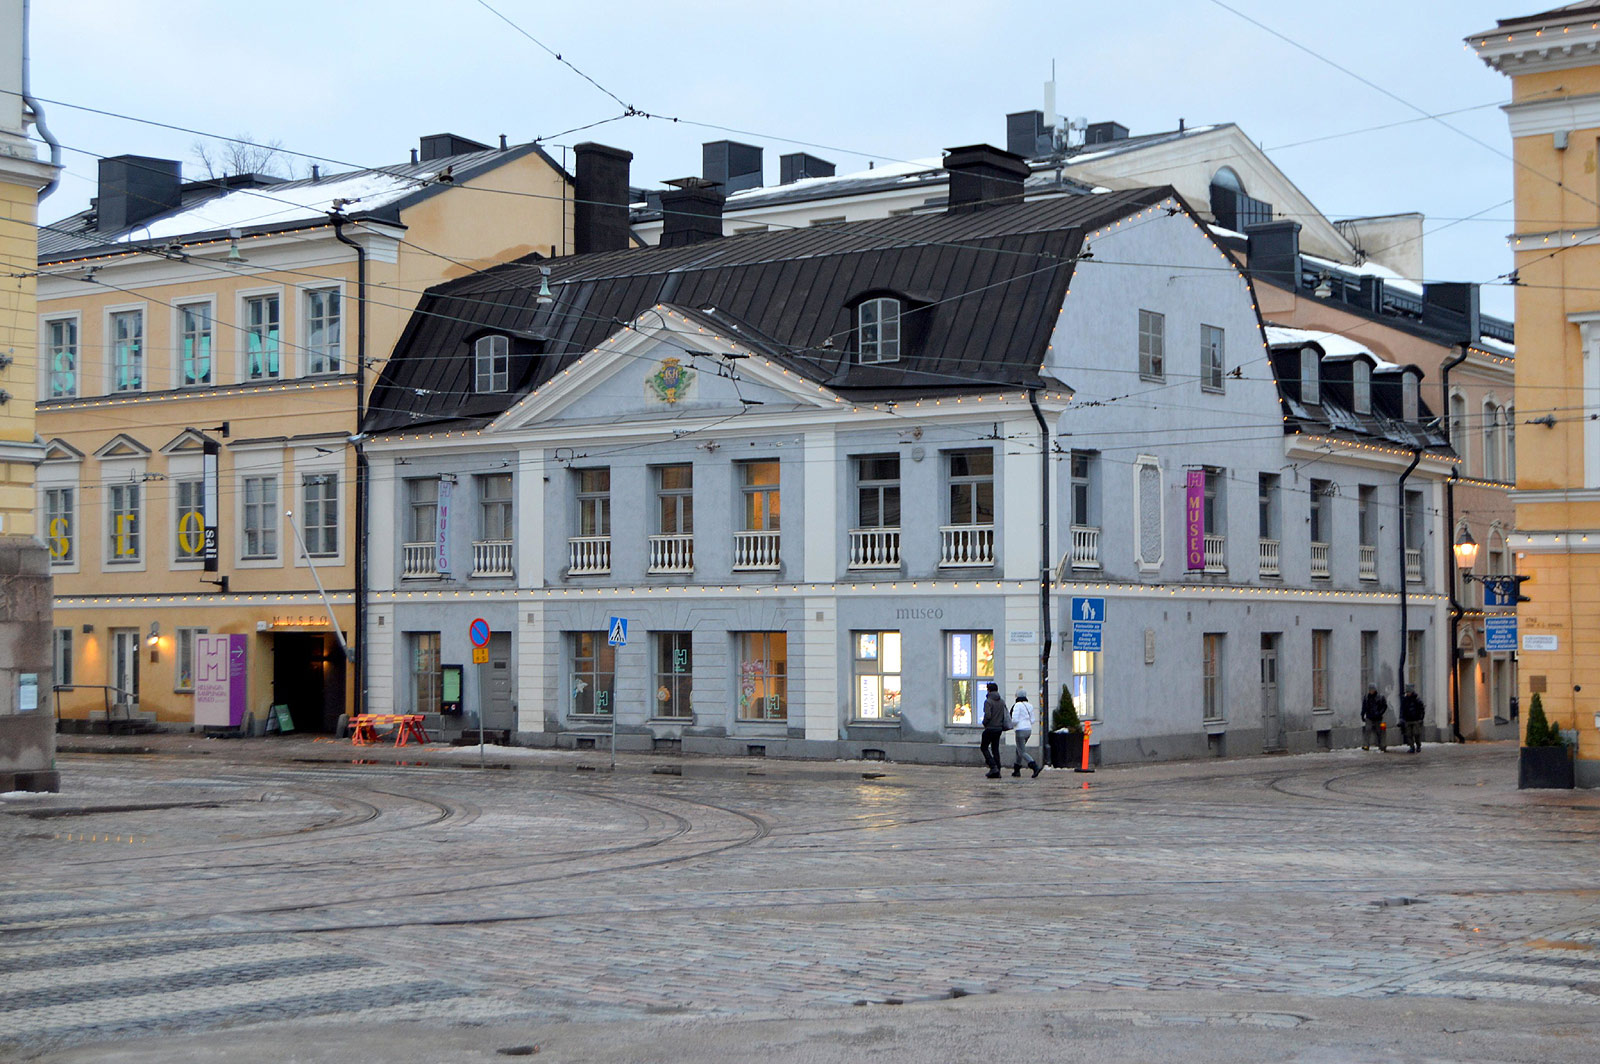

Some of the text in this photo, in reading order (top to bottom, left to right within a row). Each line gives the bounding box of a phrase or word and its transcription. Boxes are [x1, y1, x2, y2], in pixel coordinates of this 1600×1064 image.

[205, 529, 217, 559] sali
[439, 505, 448, 569] MUSEO
[1189, 496, 1201, 564] MUSEO
[273, 615, 328, 626] MUSEO
[896, 608, 944, 619] museo
